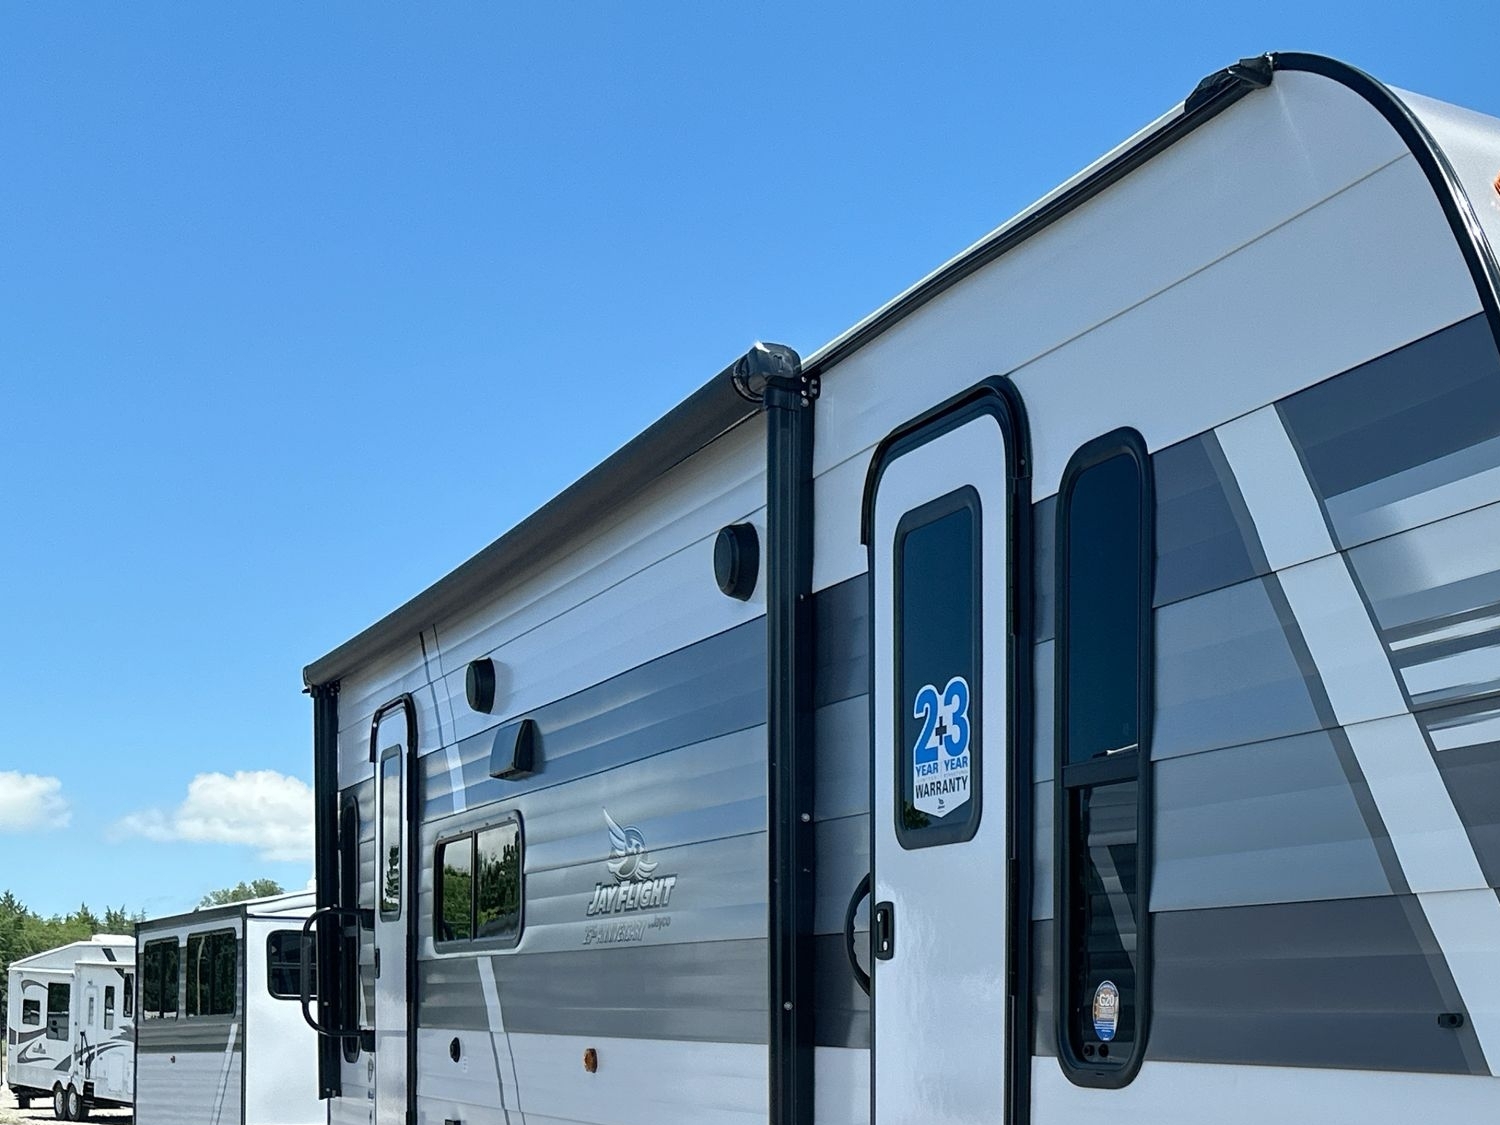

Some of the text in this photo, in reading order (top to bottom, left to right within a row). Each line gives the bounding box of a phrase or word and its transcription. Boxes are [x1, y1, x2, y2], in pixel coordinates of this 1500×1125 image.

[915, 762, 939, 777] YEAR
[944, 756, 968, 772] YEAR
[915, 775, 968, 799] WARRANTY
